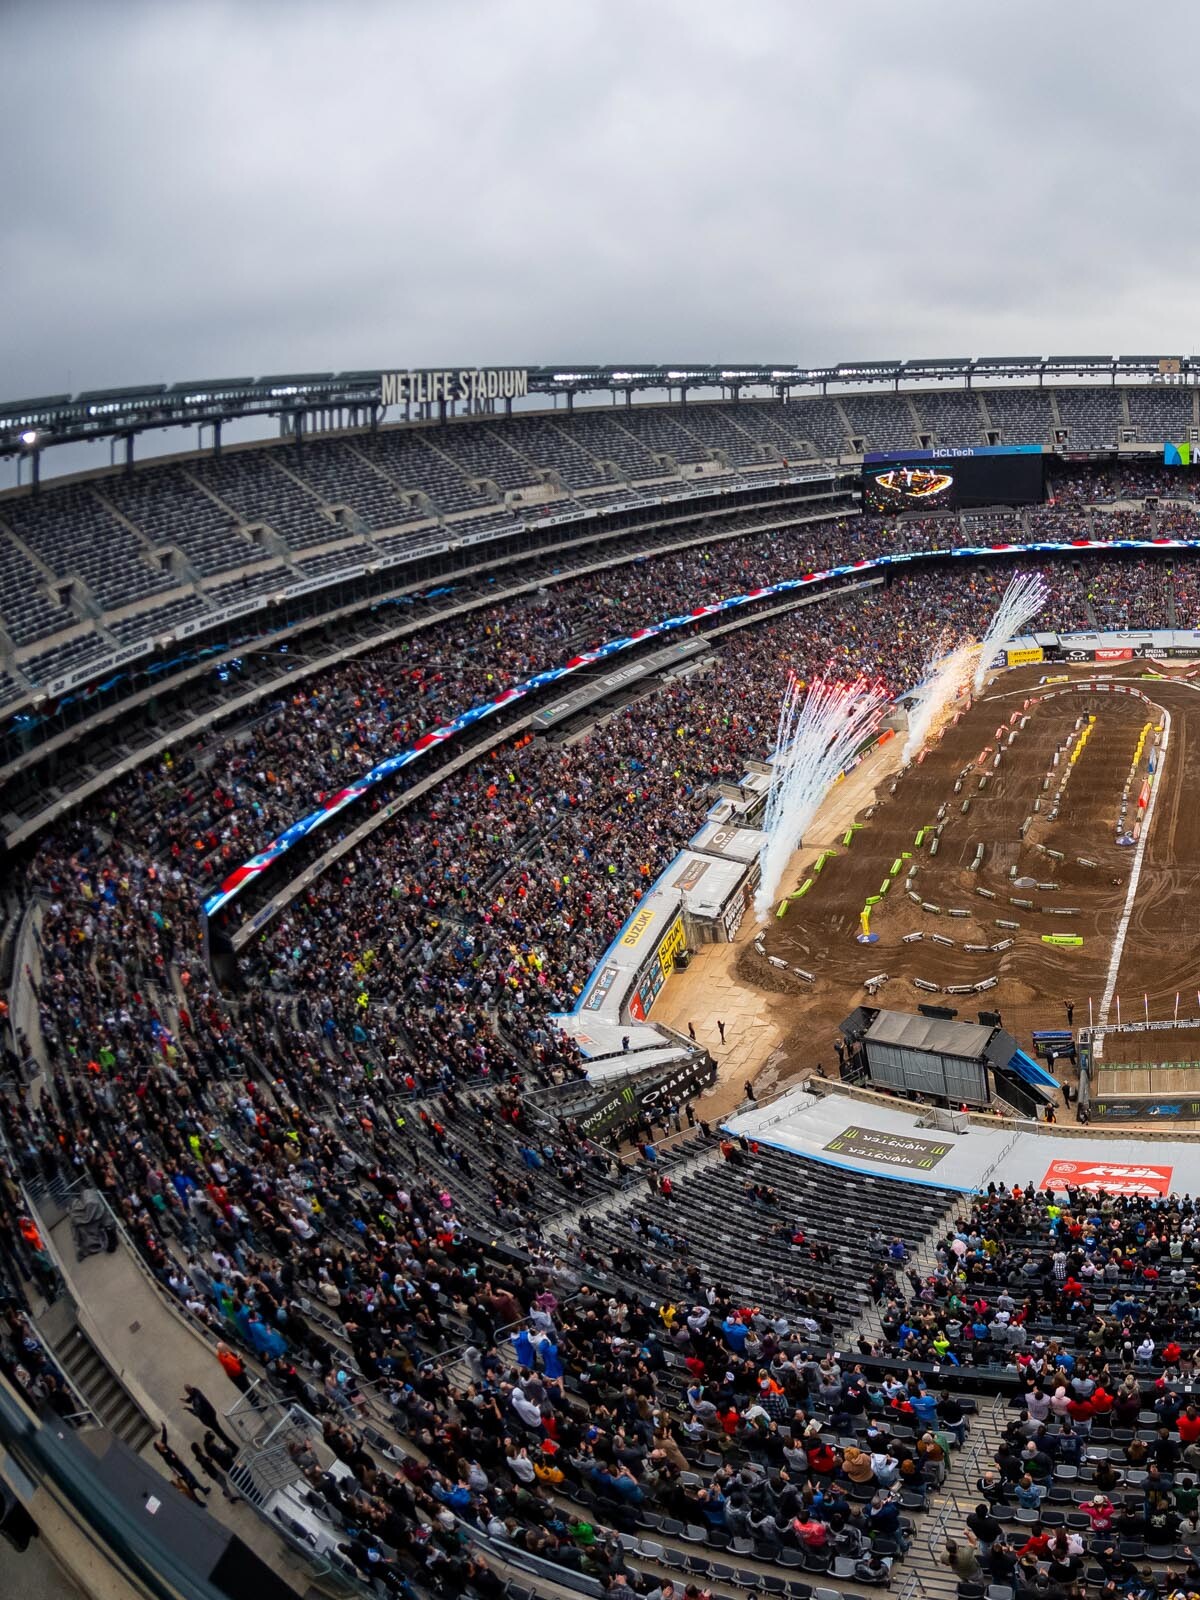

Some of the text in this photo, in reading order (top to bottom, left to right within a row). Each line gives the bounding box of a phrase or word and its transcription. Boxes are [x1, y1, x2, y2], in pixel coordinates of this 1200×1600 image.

[381, 370, 528, 405] METLIFE STADIUM
[932, 447, 974, 458] HCLTech
[71, 658, 113, 683] EMERSON
[624, 911, 653, 945] SUZUKI
[661, 920, 681, 960] SUZUKI
[661, 1057, 706, 1094] OAKLEY
